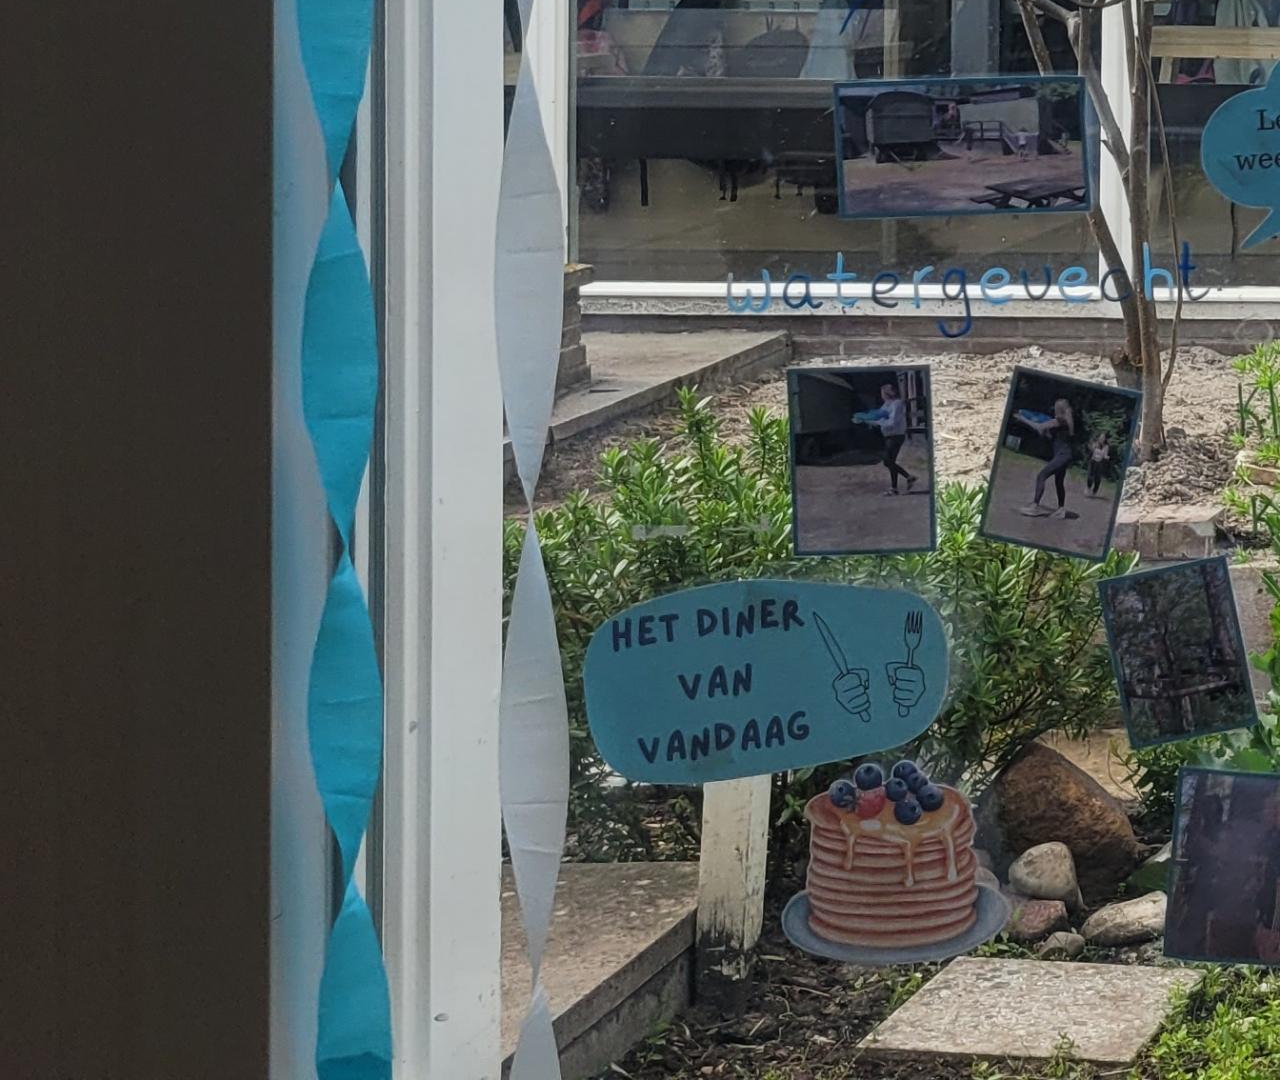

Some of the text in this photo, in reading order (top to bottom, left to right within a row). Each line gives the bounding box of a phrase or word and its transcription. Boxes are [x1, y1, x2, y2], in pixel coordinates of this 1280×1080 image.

[726, 241, 1212, 338] watergevecht
[611, 598, 805, 653] HET DINER
[677, 663, 753, 699] VAN
[637, 710, 811, 765] VANDAAG
